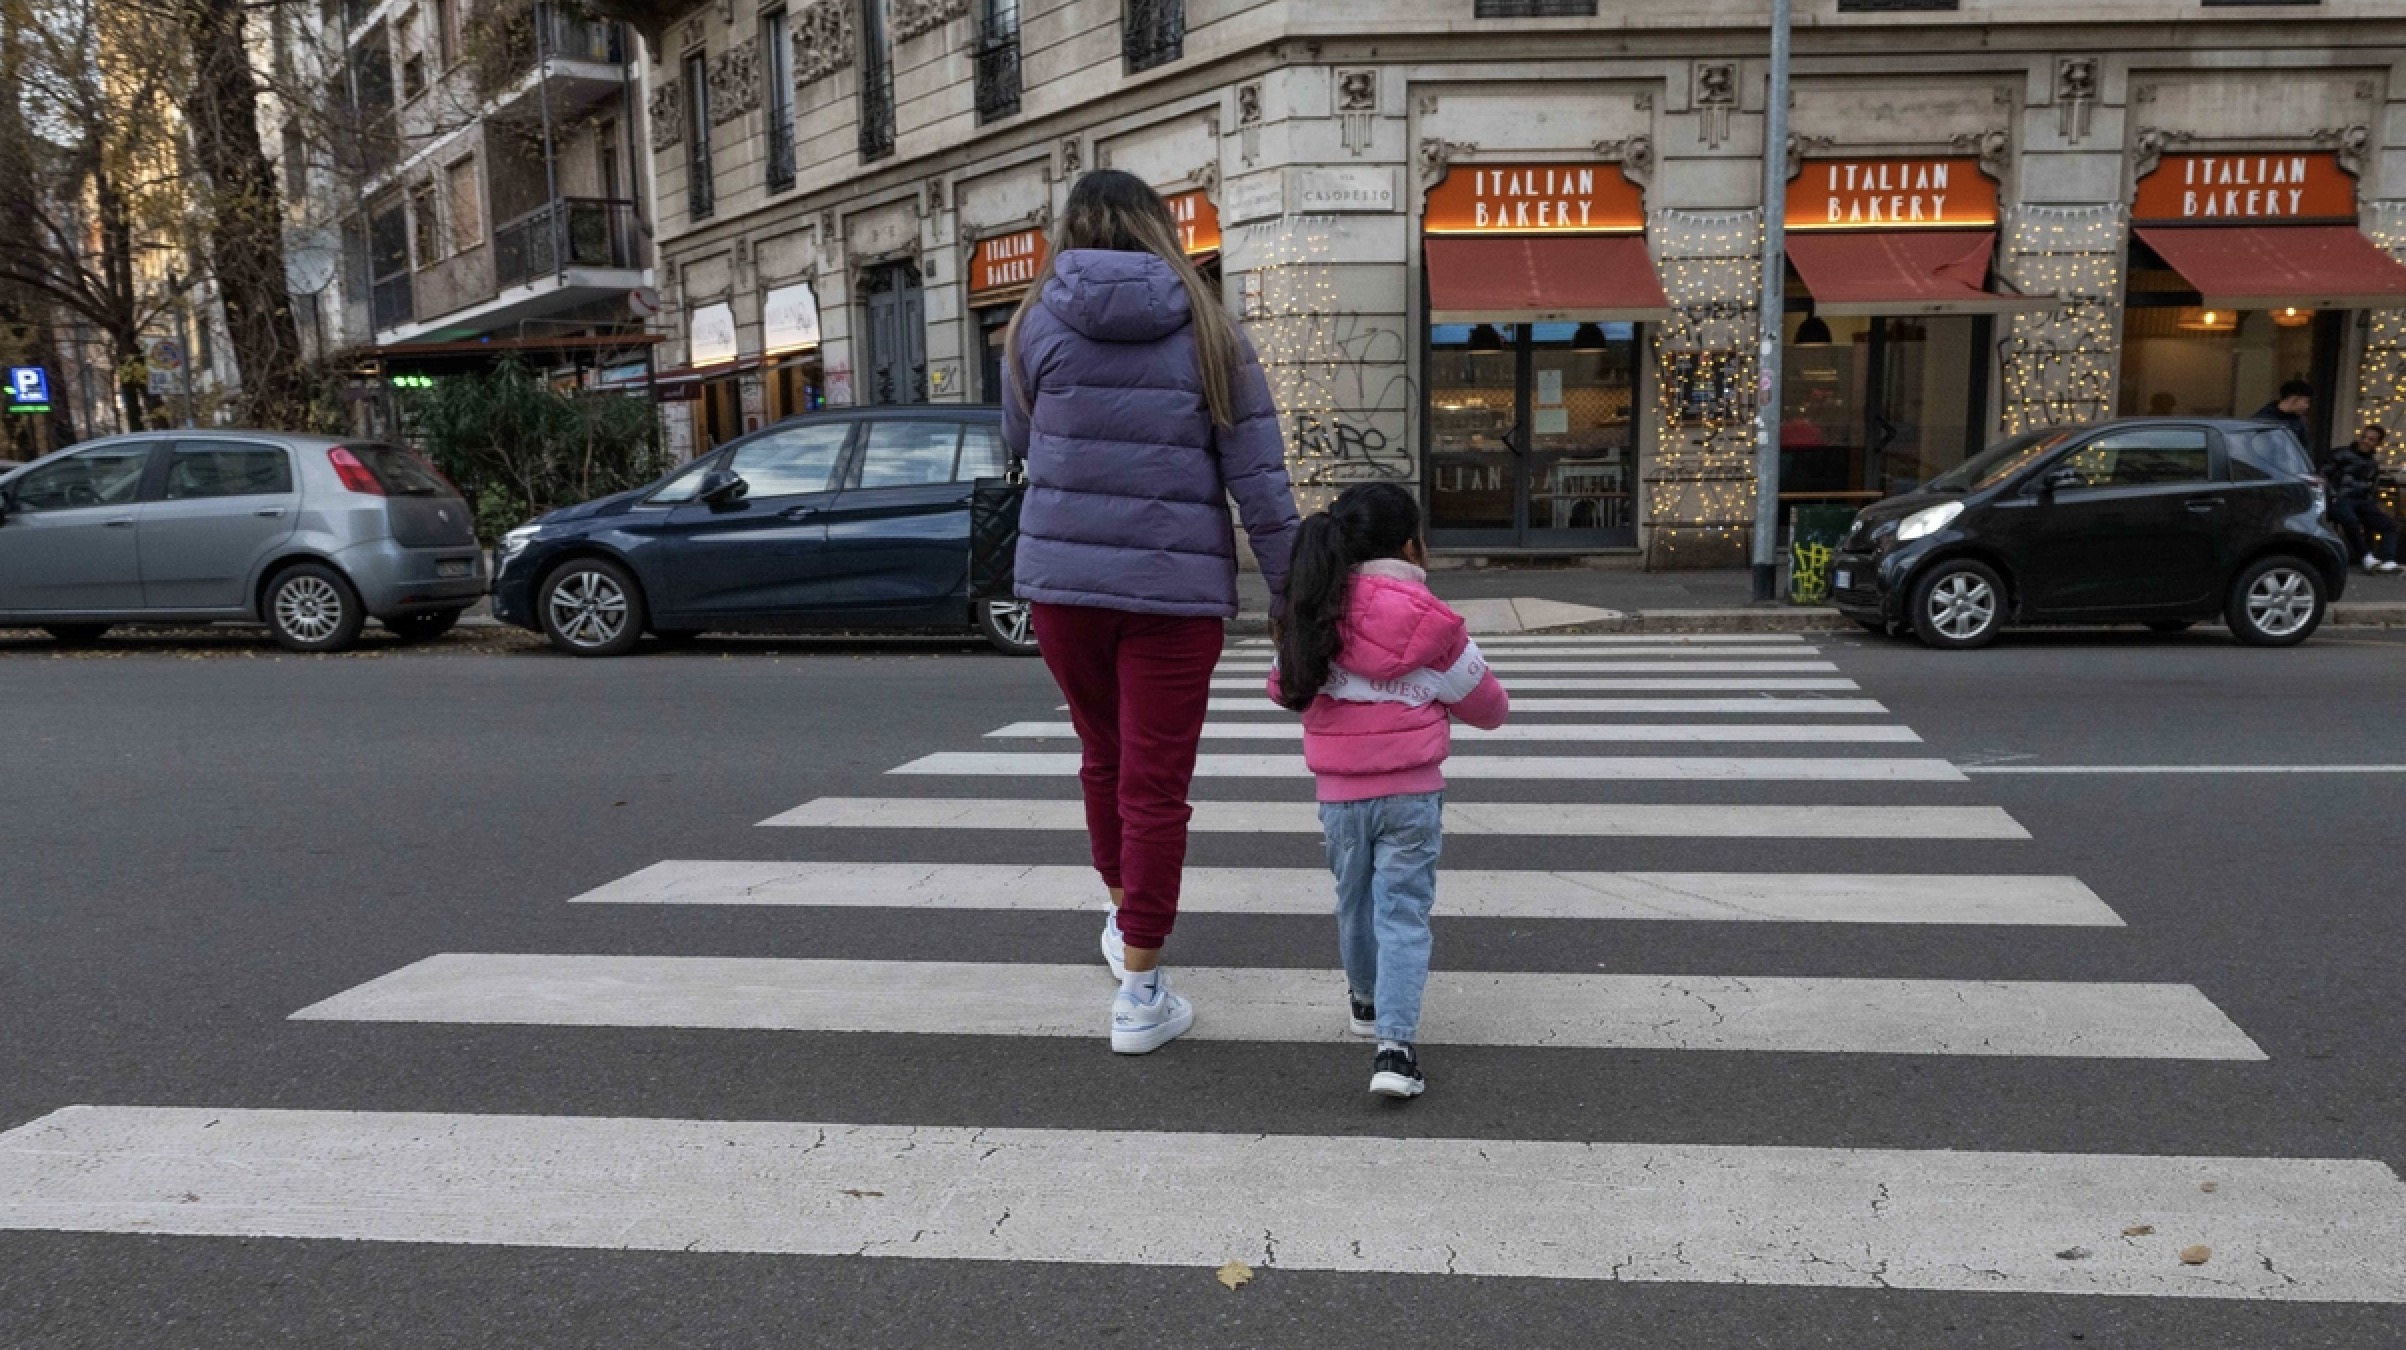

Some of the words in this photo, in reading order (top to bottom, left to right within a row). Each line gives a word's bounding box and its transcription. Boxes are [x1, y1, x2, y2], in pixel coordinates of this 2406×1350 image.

[1475, 168, 1594, 197] ITALIAN
[1828, 162, 1949, 191] ITALIAN
[2184, 157, 2306, 185] ITALIAN
[1475, 200, 1593, 228] BAKERY
[1827, 194, 1947, 223] BAKERY
[2183, 188, 2304, 217] BAKERY
[986, 232, 1034, 263] ITALIAN
[987, 257, 1034, 287] BAKERY
[1435, 465, 1501, 493] LIAN
[1369, 678, 1431, 700] GUESS
